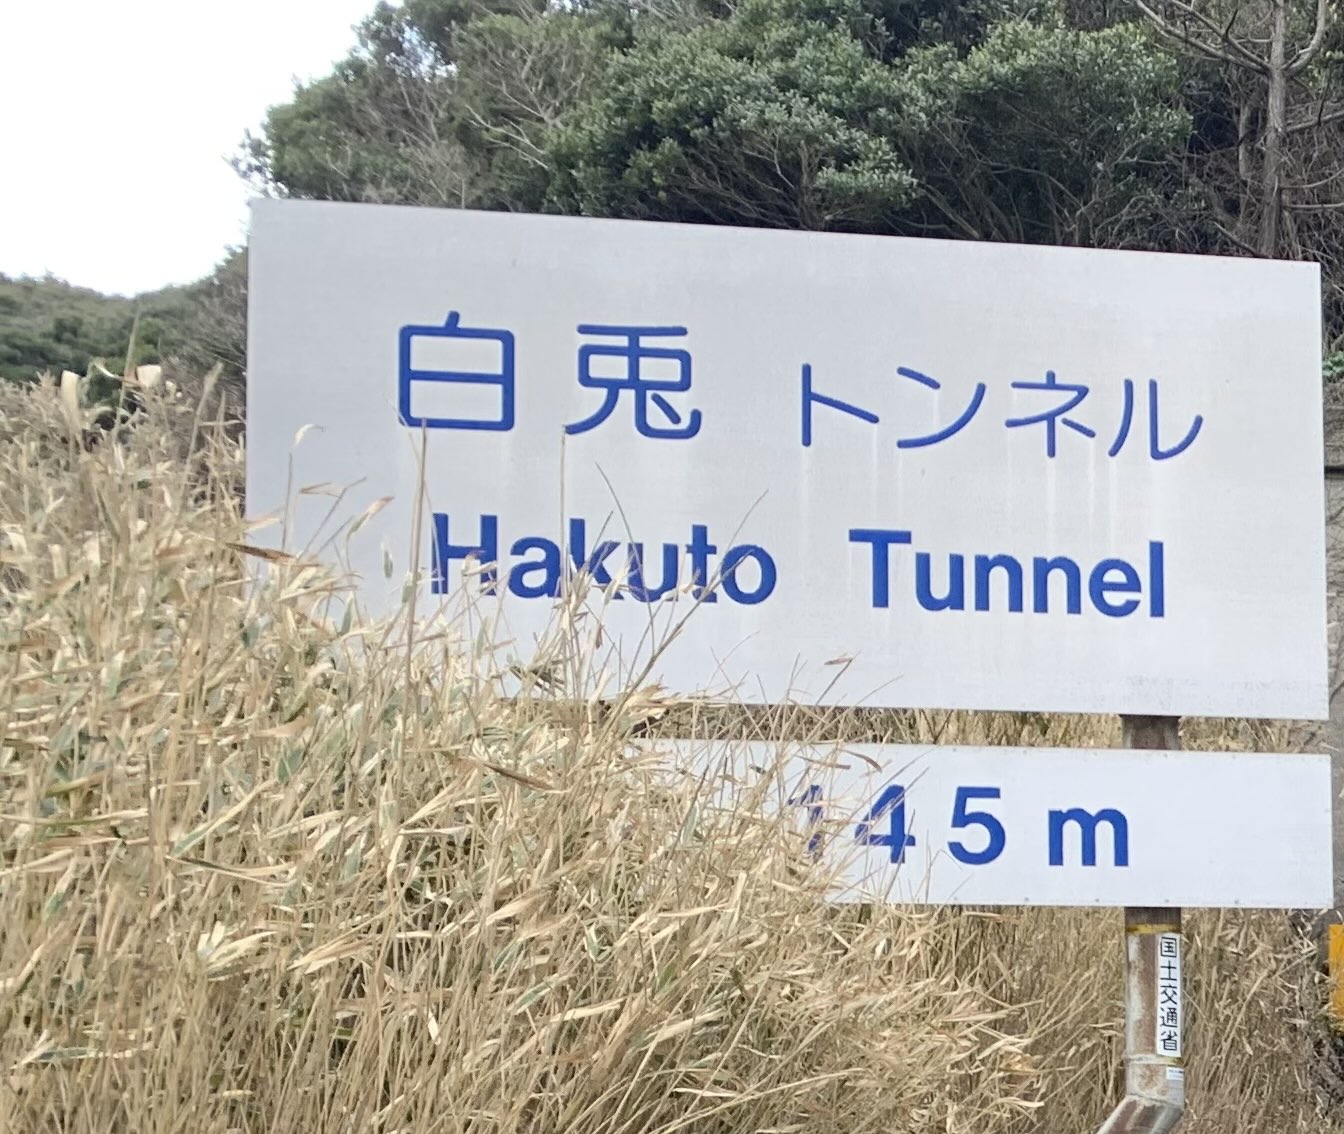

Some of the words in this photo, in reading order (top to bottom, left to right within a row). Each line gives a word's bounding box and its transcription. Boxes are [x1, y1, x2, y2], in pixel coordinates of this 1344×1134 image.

[398, 311, 703, 440] 白兎
[800, 363, 1202, 461] トンネル
[431, 512, 777, 606] Hakuto
[848, 528, 1166, 619] Tunnel
[1047, 806, 1130, 868] m
[1159, 936, 1179, 1052] 国土交通省
